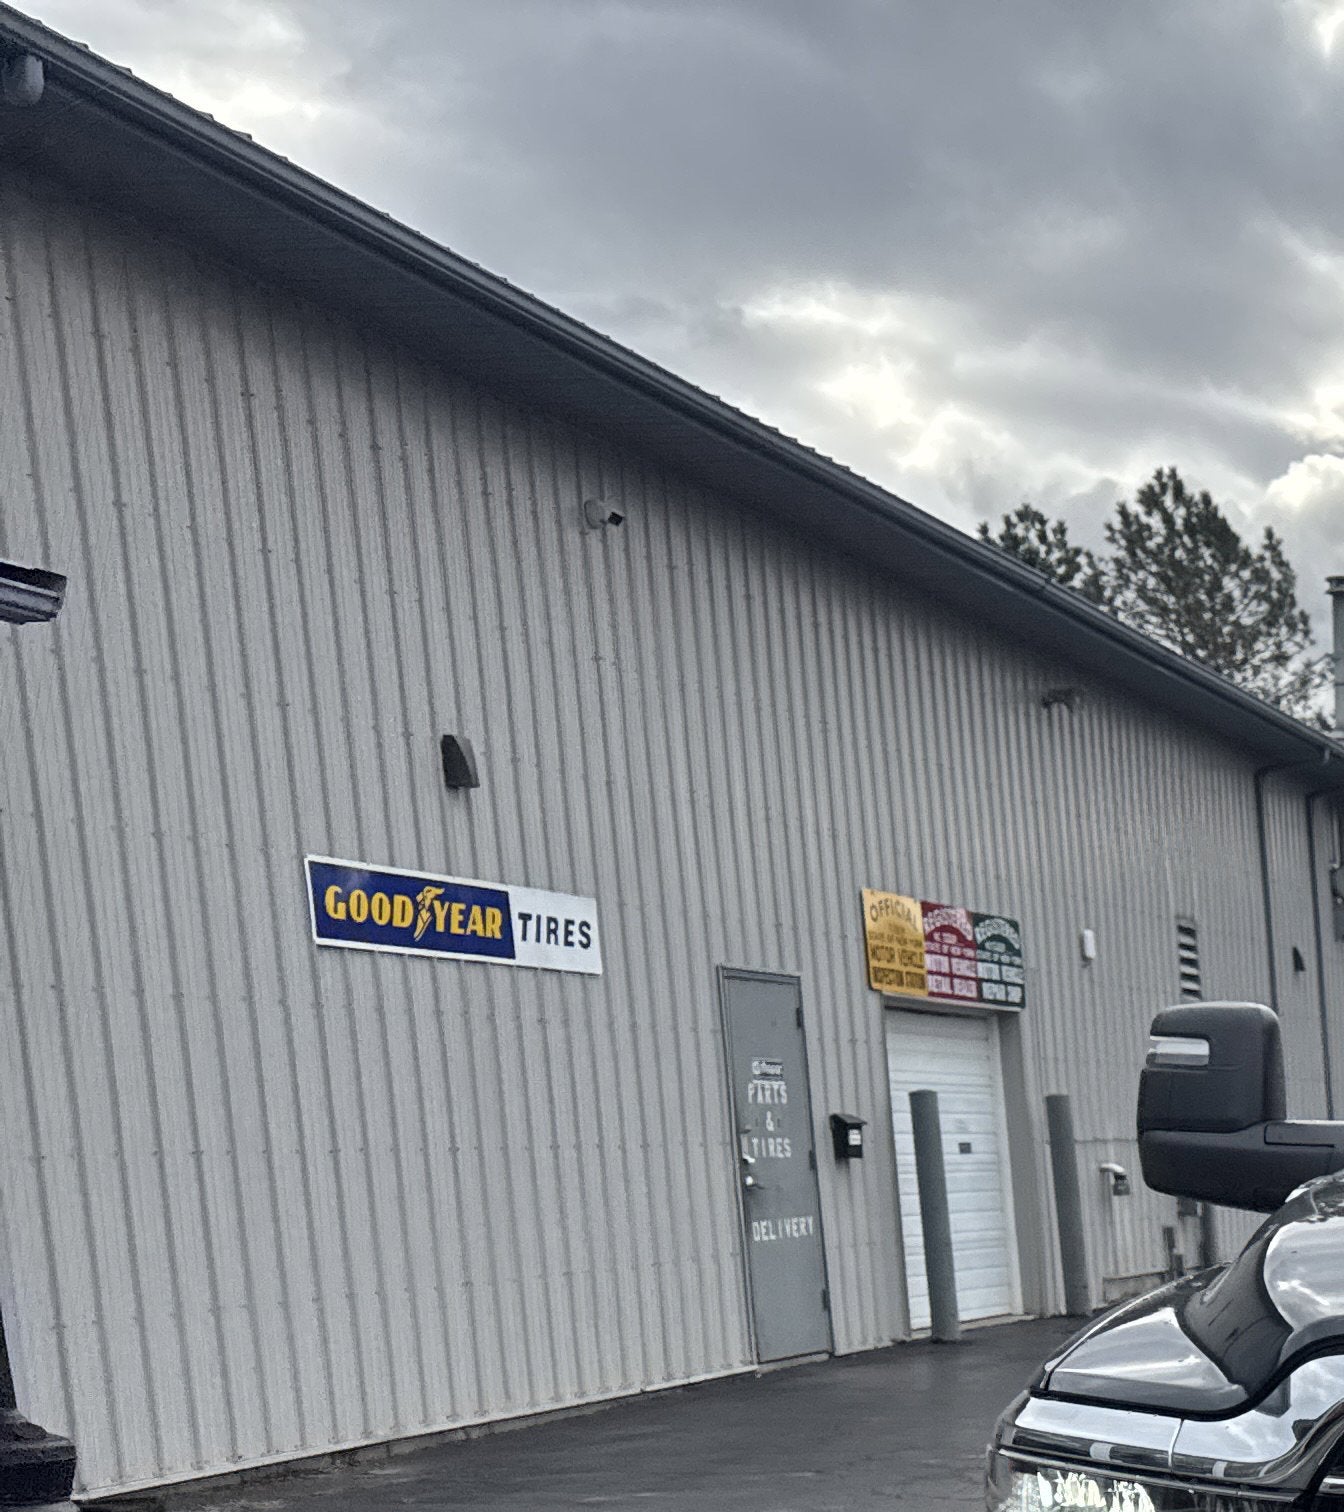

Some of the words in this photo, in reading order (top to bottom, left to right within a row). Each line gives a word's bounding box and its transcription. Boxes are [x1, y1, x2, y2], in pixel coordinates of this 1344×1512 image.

[869, 897, 919, 932] OFFICIAL
[518, 912, 591, 949] TIRES
[748, 1082, 787, 1104] PARTS
[765, 1110, 775, 1131] &
[752, 1138, 792, 1158] TIRES
[752, 1216, 813, 1241] DELIVERY
